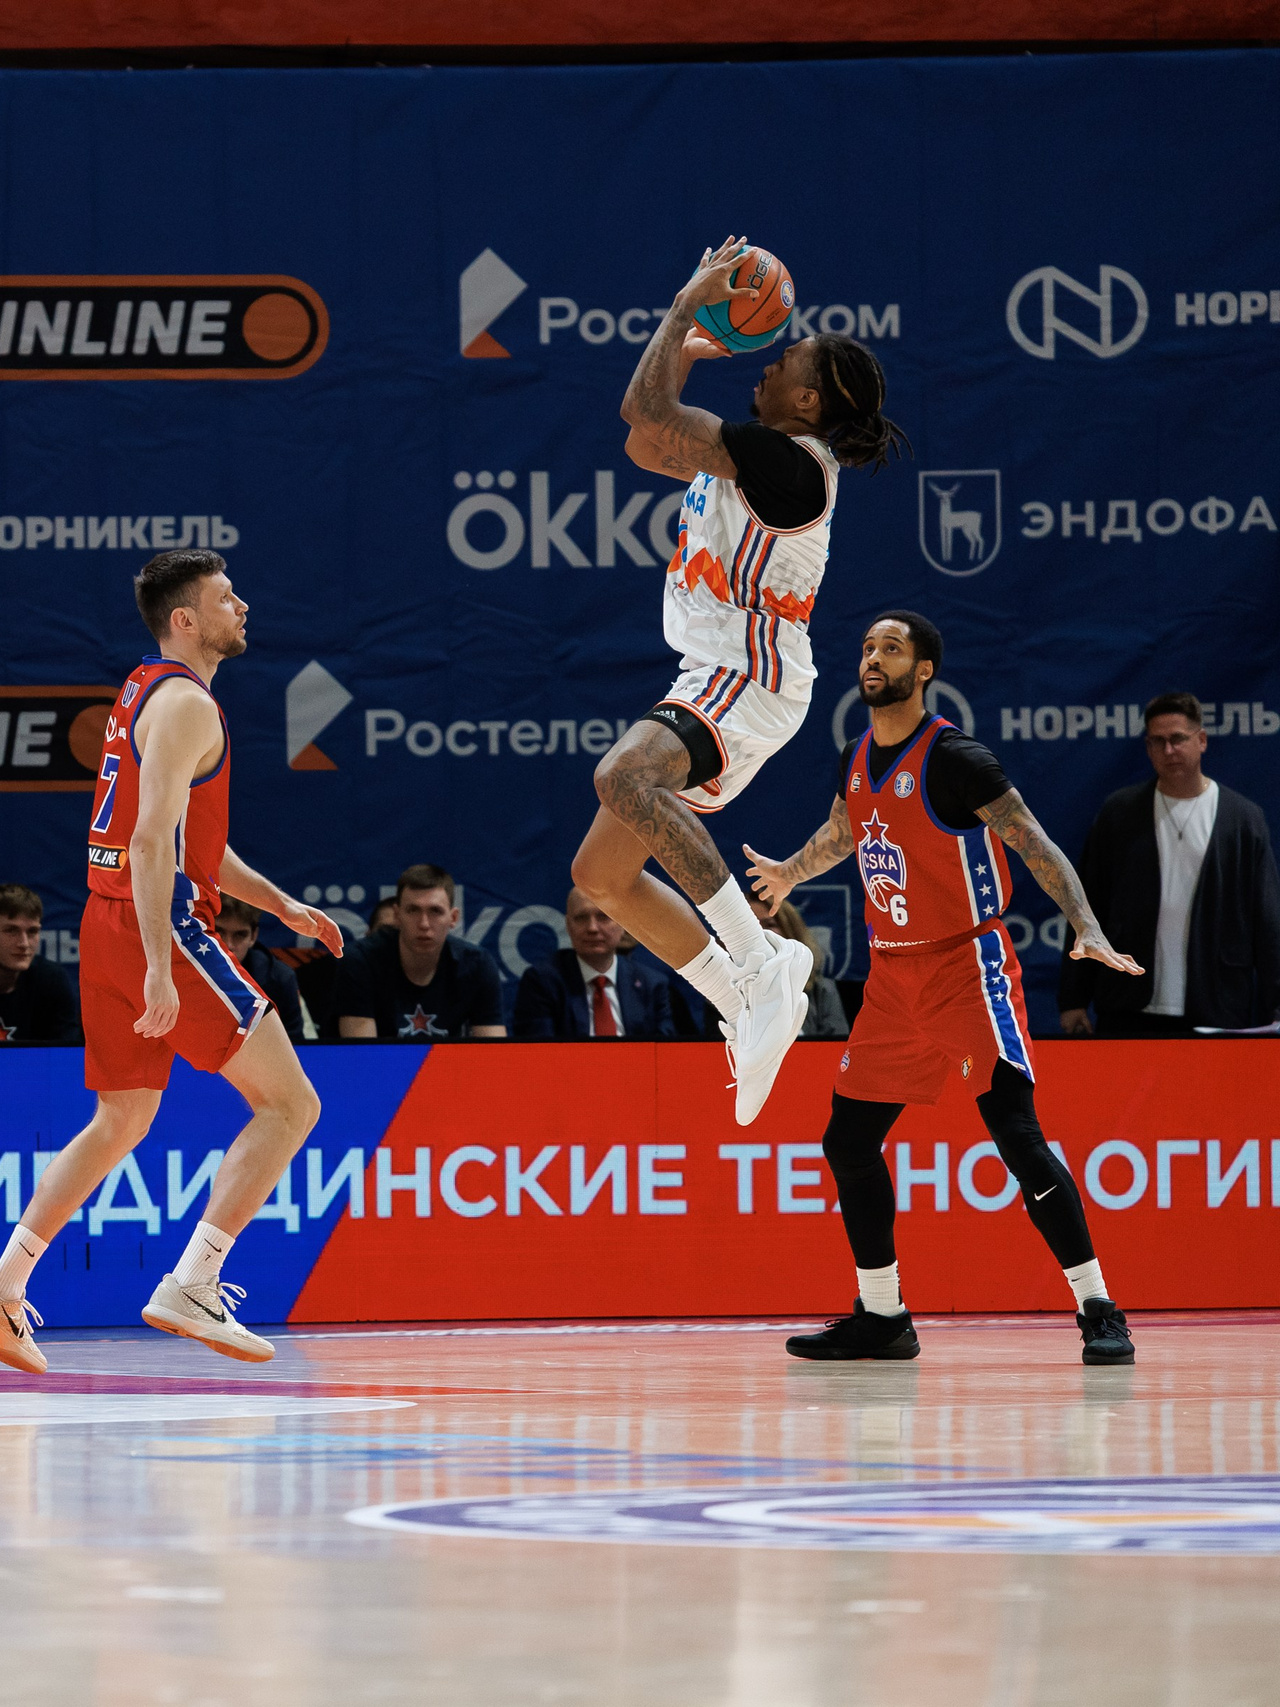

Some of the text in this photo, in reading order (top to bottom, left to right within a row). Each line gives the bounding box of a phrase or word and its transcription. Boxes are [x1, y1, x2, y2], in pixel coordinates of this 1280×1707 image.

[539, 297, 900, 345] Роском
[1021, 496, 1278, 544] ЭНДОФА
[1001, 701, 1280, 741] НОРНИЕЛЬ
[90, 752, 121, 834] 7
[863, 852, 898, 871] CSKA
[889, 894, 909, 927] 6
[719, 1139, 1280, 1214] ТЕНООГИ
